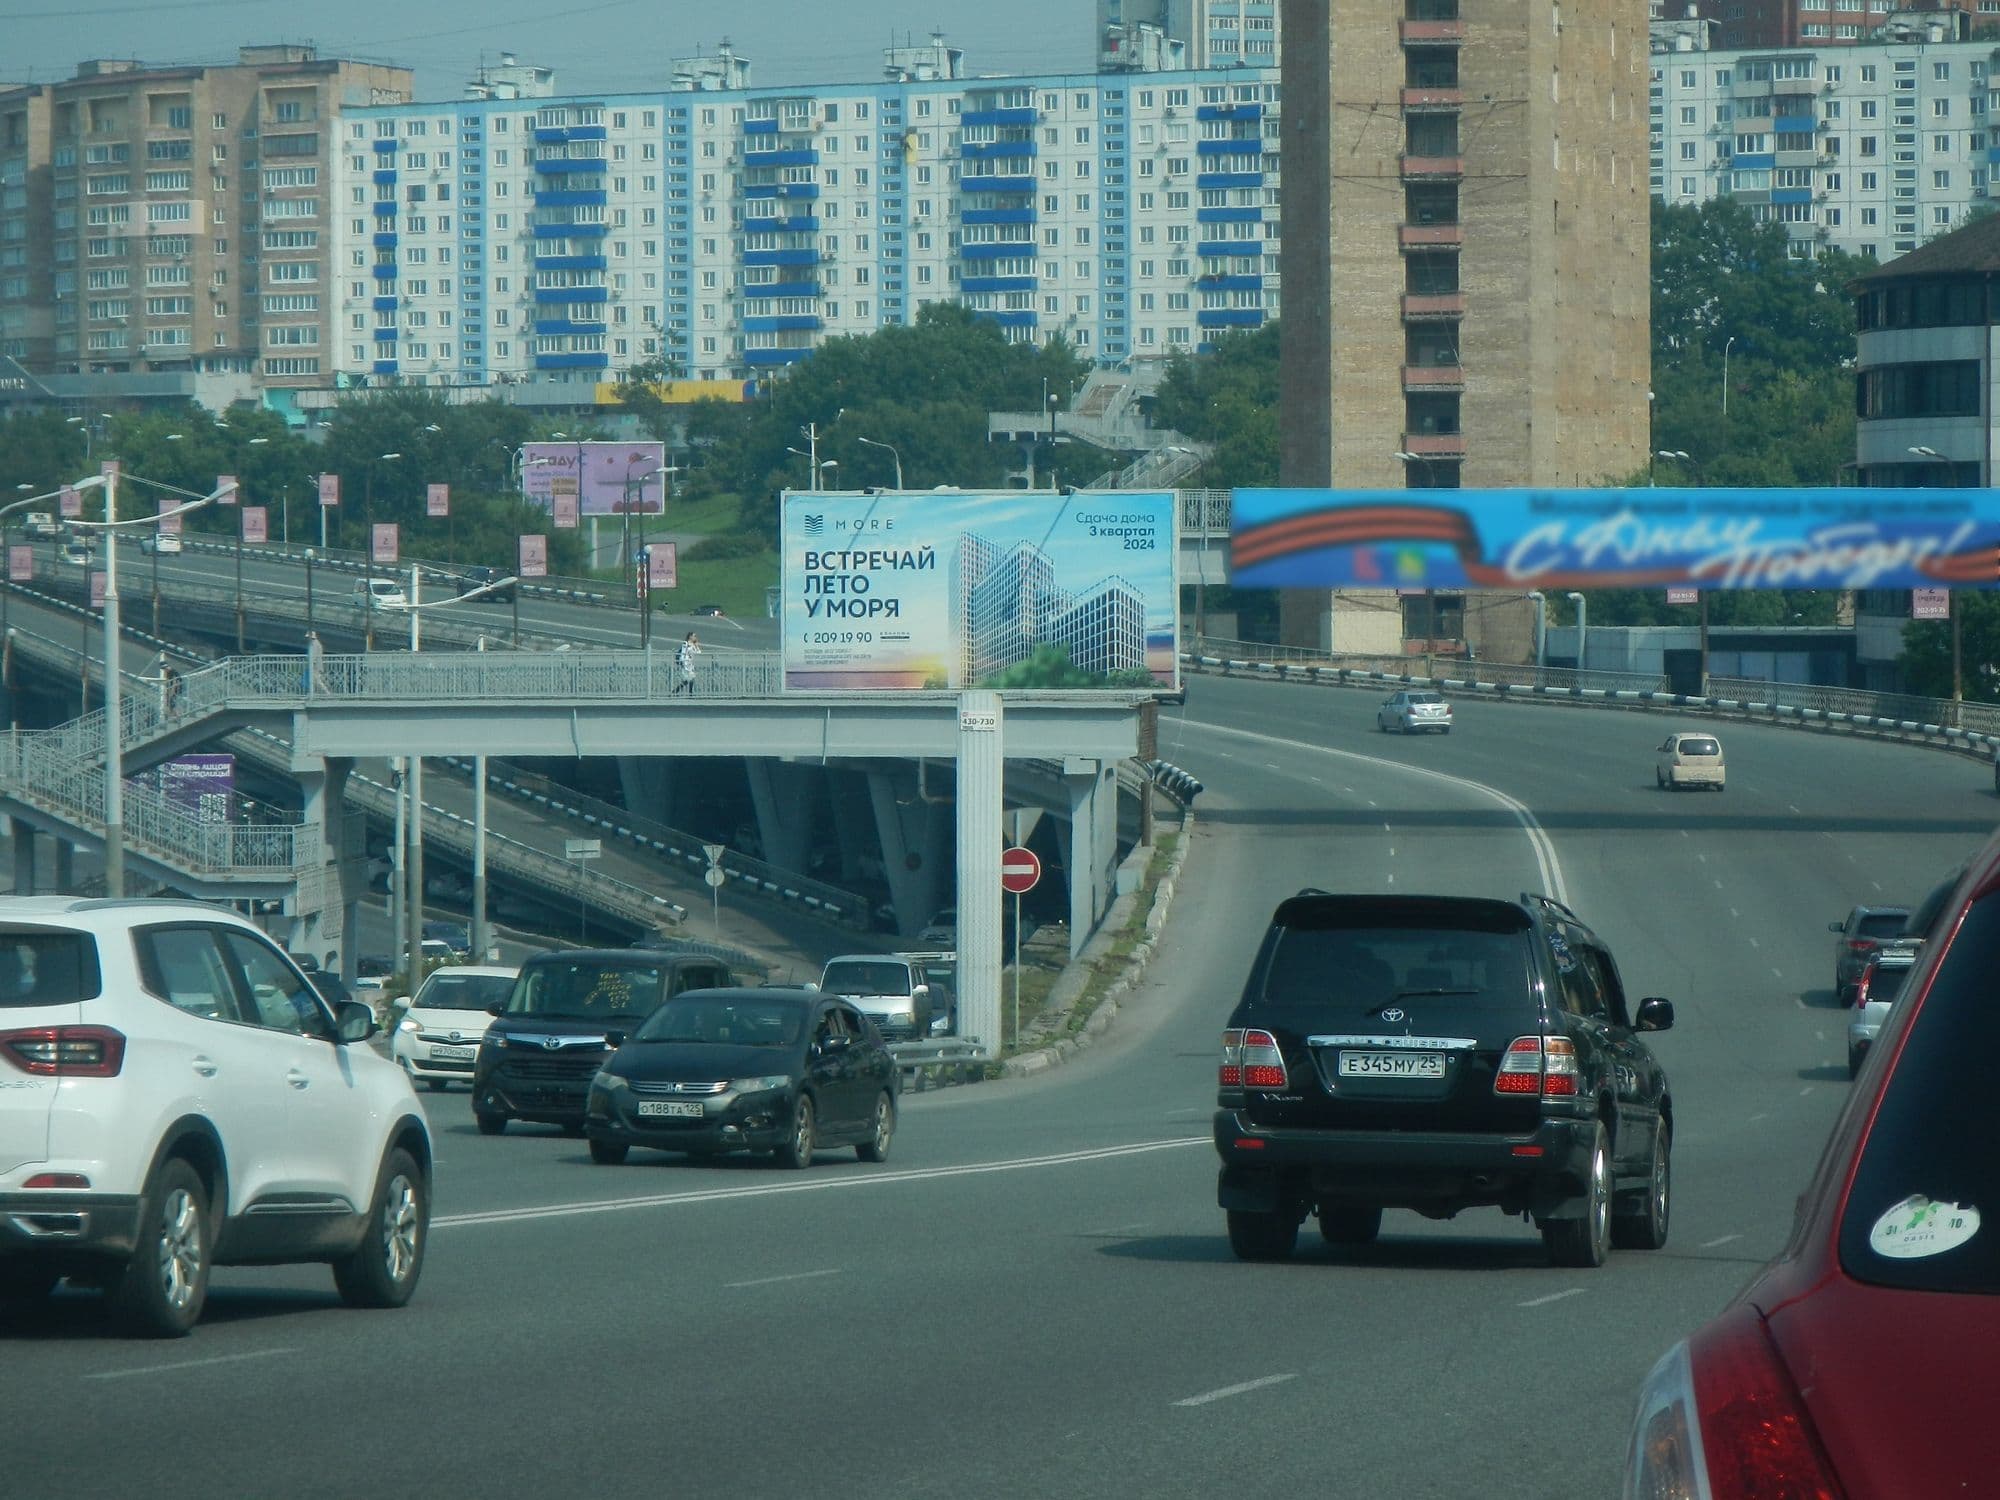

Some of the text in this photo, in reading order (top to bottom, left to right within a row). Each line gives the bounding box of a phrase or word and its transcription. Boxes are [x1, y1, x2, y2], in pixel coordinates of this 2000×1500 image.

[1075, 512, 1155, 524] Сдача дома
[835, 519, 894, 530] MORE
[1089, 525, 1155, 538] 3 квартал
[1123, 538, 1155, 550] 2024
[804, 545, 935, 571] ВСТРЕЧАЙ
[803, 574, 870, 594] ЛЕТО
[804, 598, 899, 618] У МОРЯ
[814, 632, 838, 643] 209
[840, 632, 853, 643] 19
[856, 632, 872, 643] 90
[1420, 1056, 1437, 1068] 25
